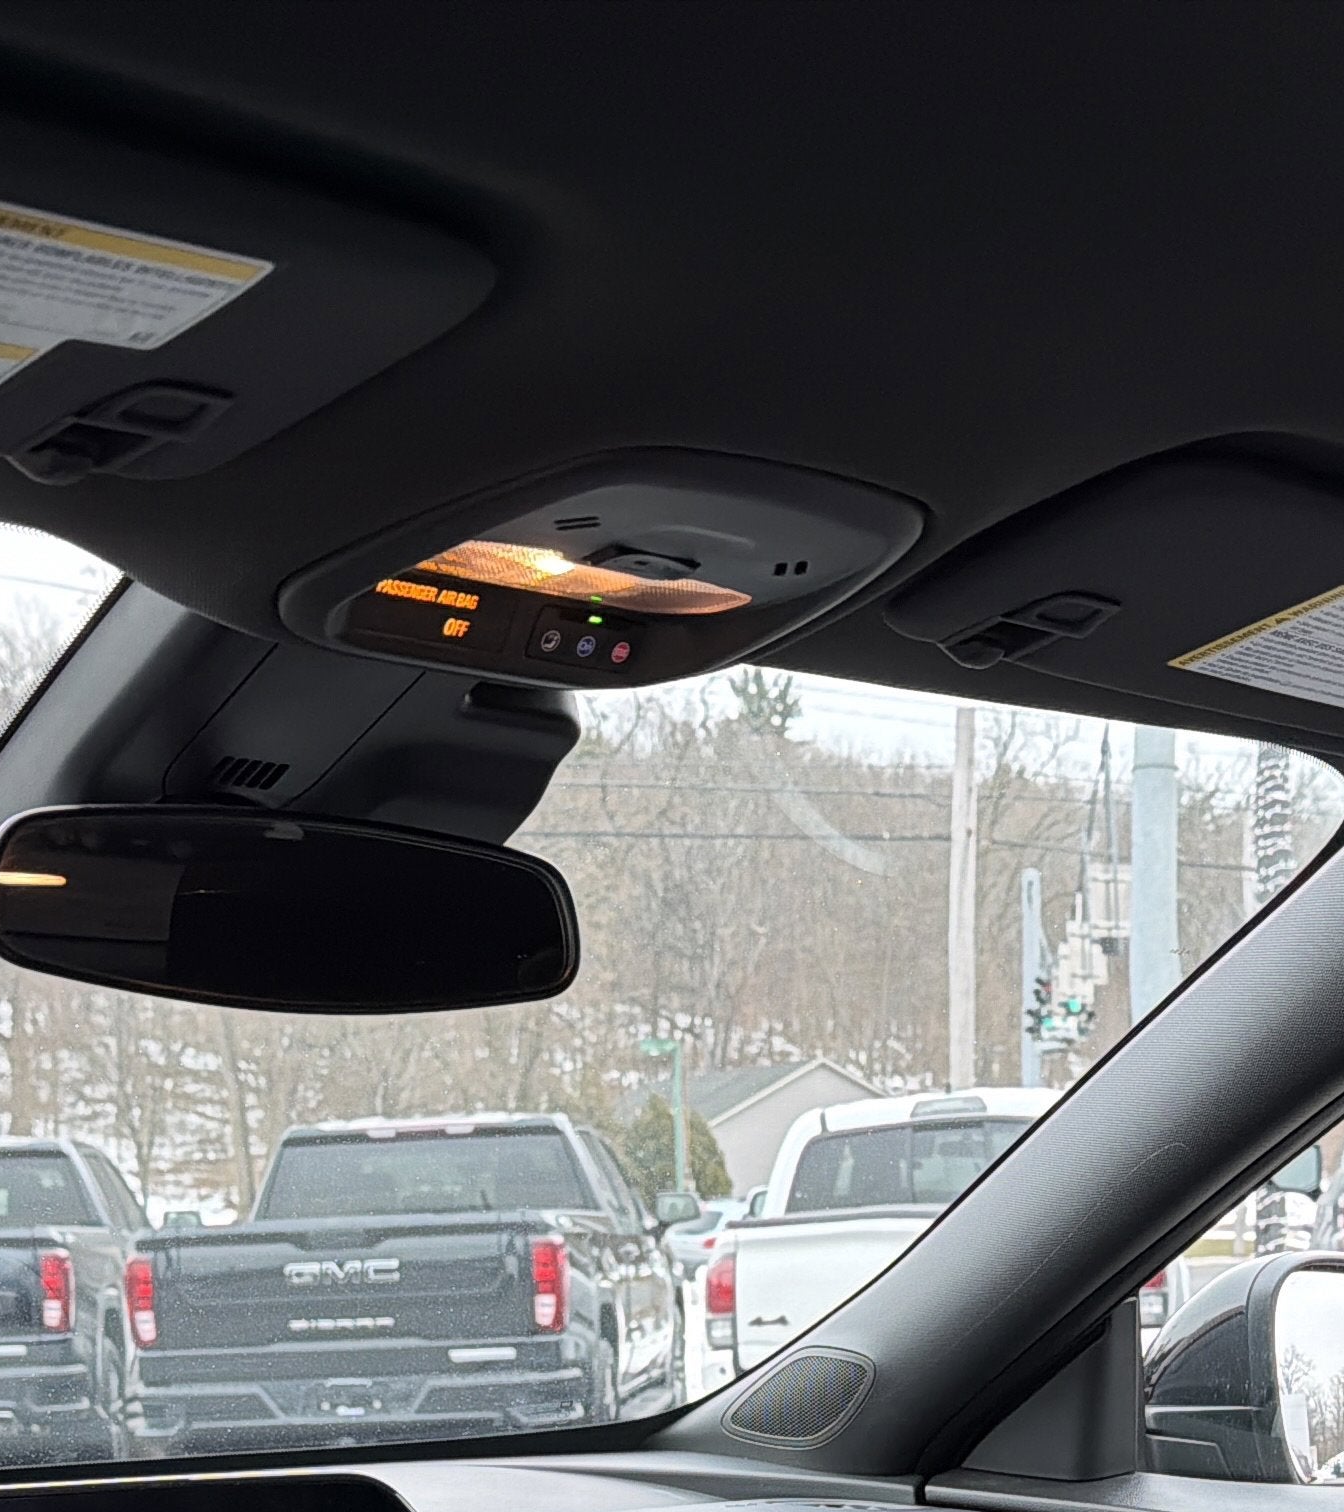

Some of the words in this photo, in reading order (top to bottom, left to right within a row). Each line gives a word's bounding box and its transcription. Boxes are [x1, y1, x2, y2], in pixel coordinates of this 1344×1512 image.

[376, 579, 438, 602] PASSENGER
[443, 617, 471, 637] OFF
[283, 1258, 400, 1286] GMC
